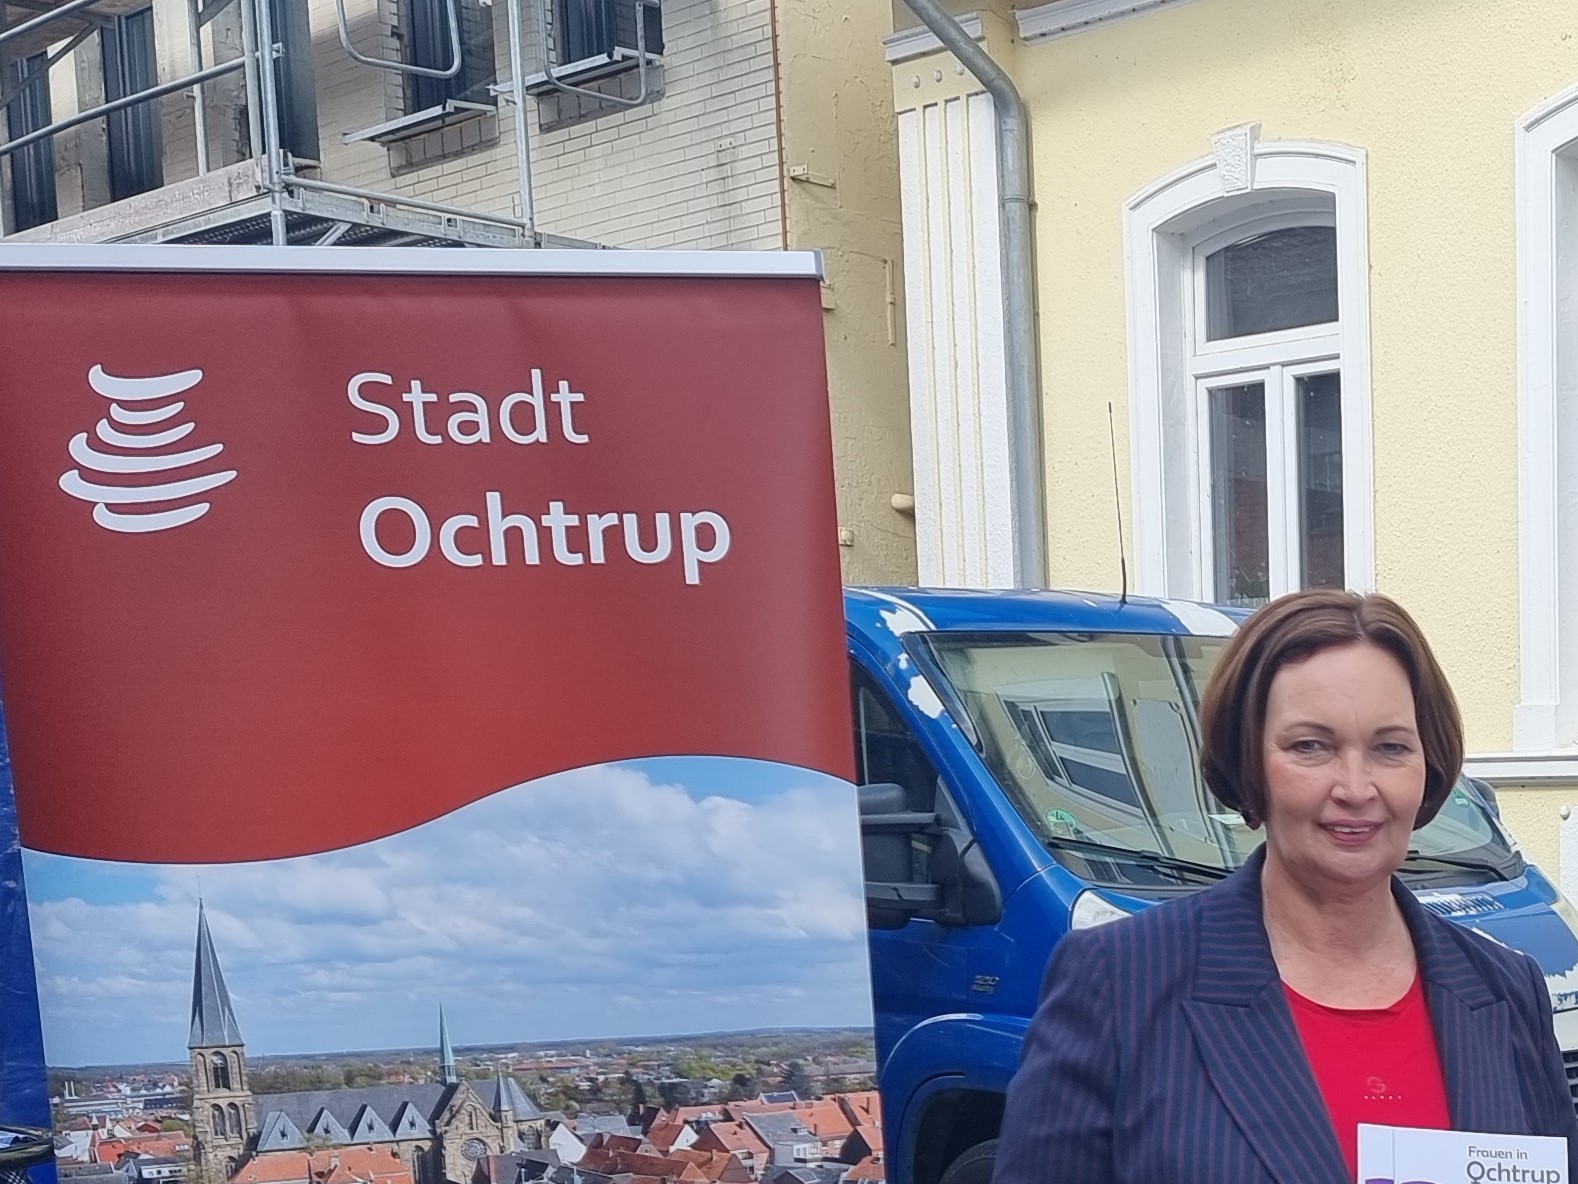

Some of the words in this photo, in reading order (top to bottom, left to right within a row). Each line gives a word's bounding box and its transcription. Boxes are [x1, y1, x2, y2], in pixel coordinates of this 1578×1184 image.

[347, 368, 589, 446] Stadt
[359, 491, 732, 586] Ochtrup
[1468, 1145, 1513, 1160] Frauen
[1516, 1148, 1529, 1160] in
